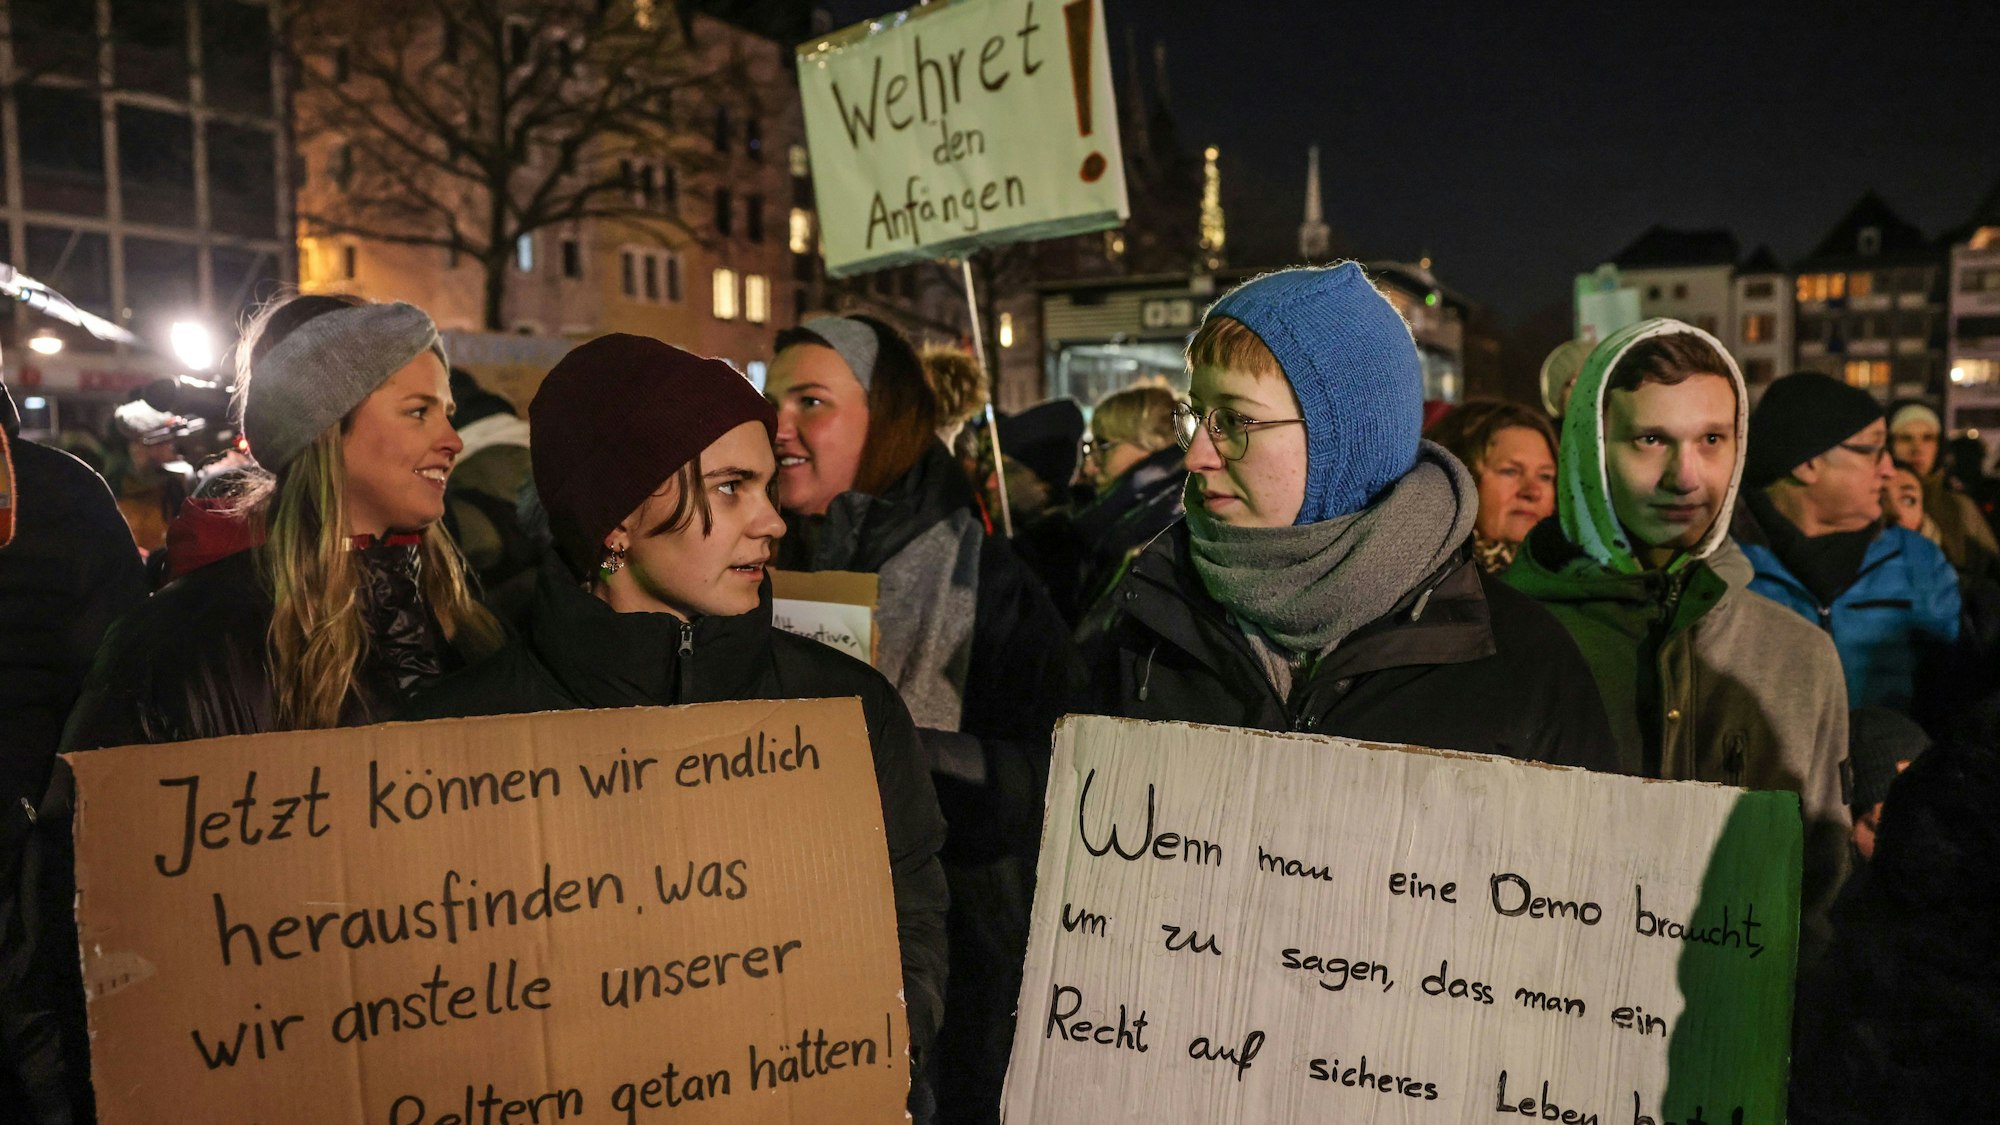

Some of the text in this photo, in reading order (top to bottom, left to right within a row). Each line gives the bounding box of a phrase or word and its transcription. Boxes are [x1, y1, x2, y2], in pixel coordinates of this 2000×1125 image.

[832, 2, 1044, 149] Wehret
[932, 118, 985, 166] den
[866, 174, 1026, 250] Anfängen
[155, 725, 819, 877] Jetzt können wir endlich
[1080, 769, 1764, 958] Wenn man eine Demo braucht,
[213, 860, 747, 966] herausfinden, was
[1062, 903, 1666, 1037] um zu sagen, dass man ein
[192, 941, 801, 1069] wir anstelle unserer
[612, 1063, 730, 1125] getan
[749, 1013, 891, 1090] hätten!
[1047, 984, 1148, 1052] Recht
[1189, 1031, 1265, 1082] auf
[1310, 1056, 1438, 1100] sicheres
[1496, 1070, 1597, 1125] Leben
